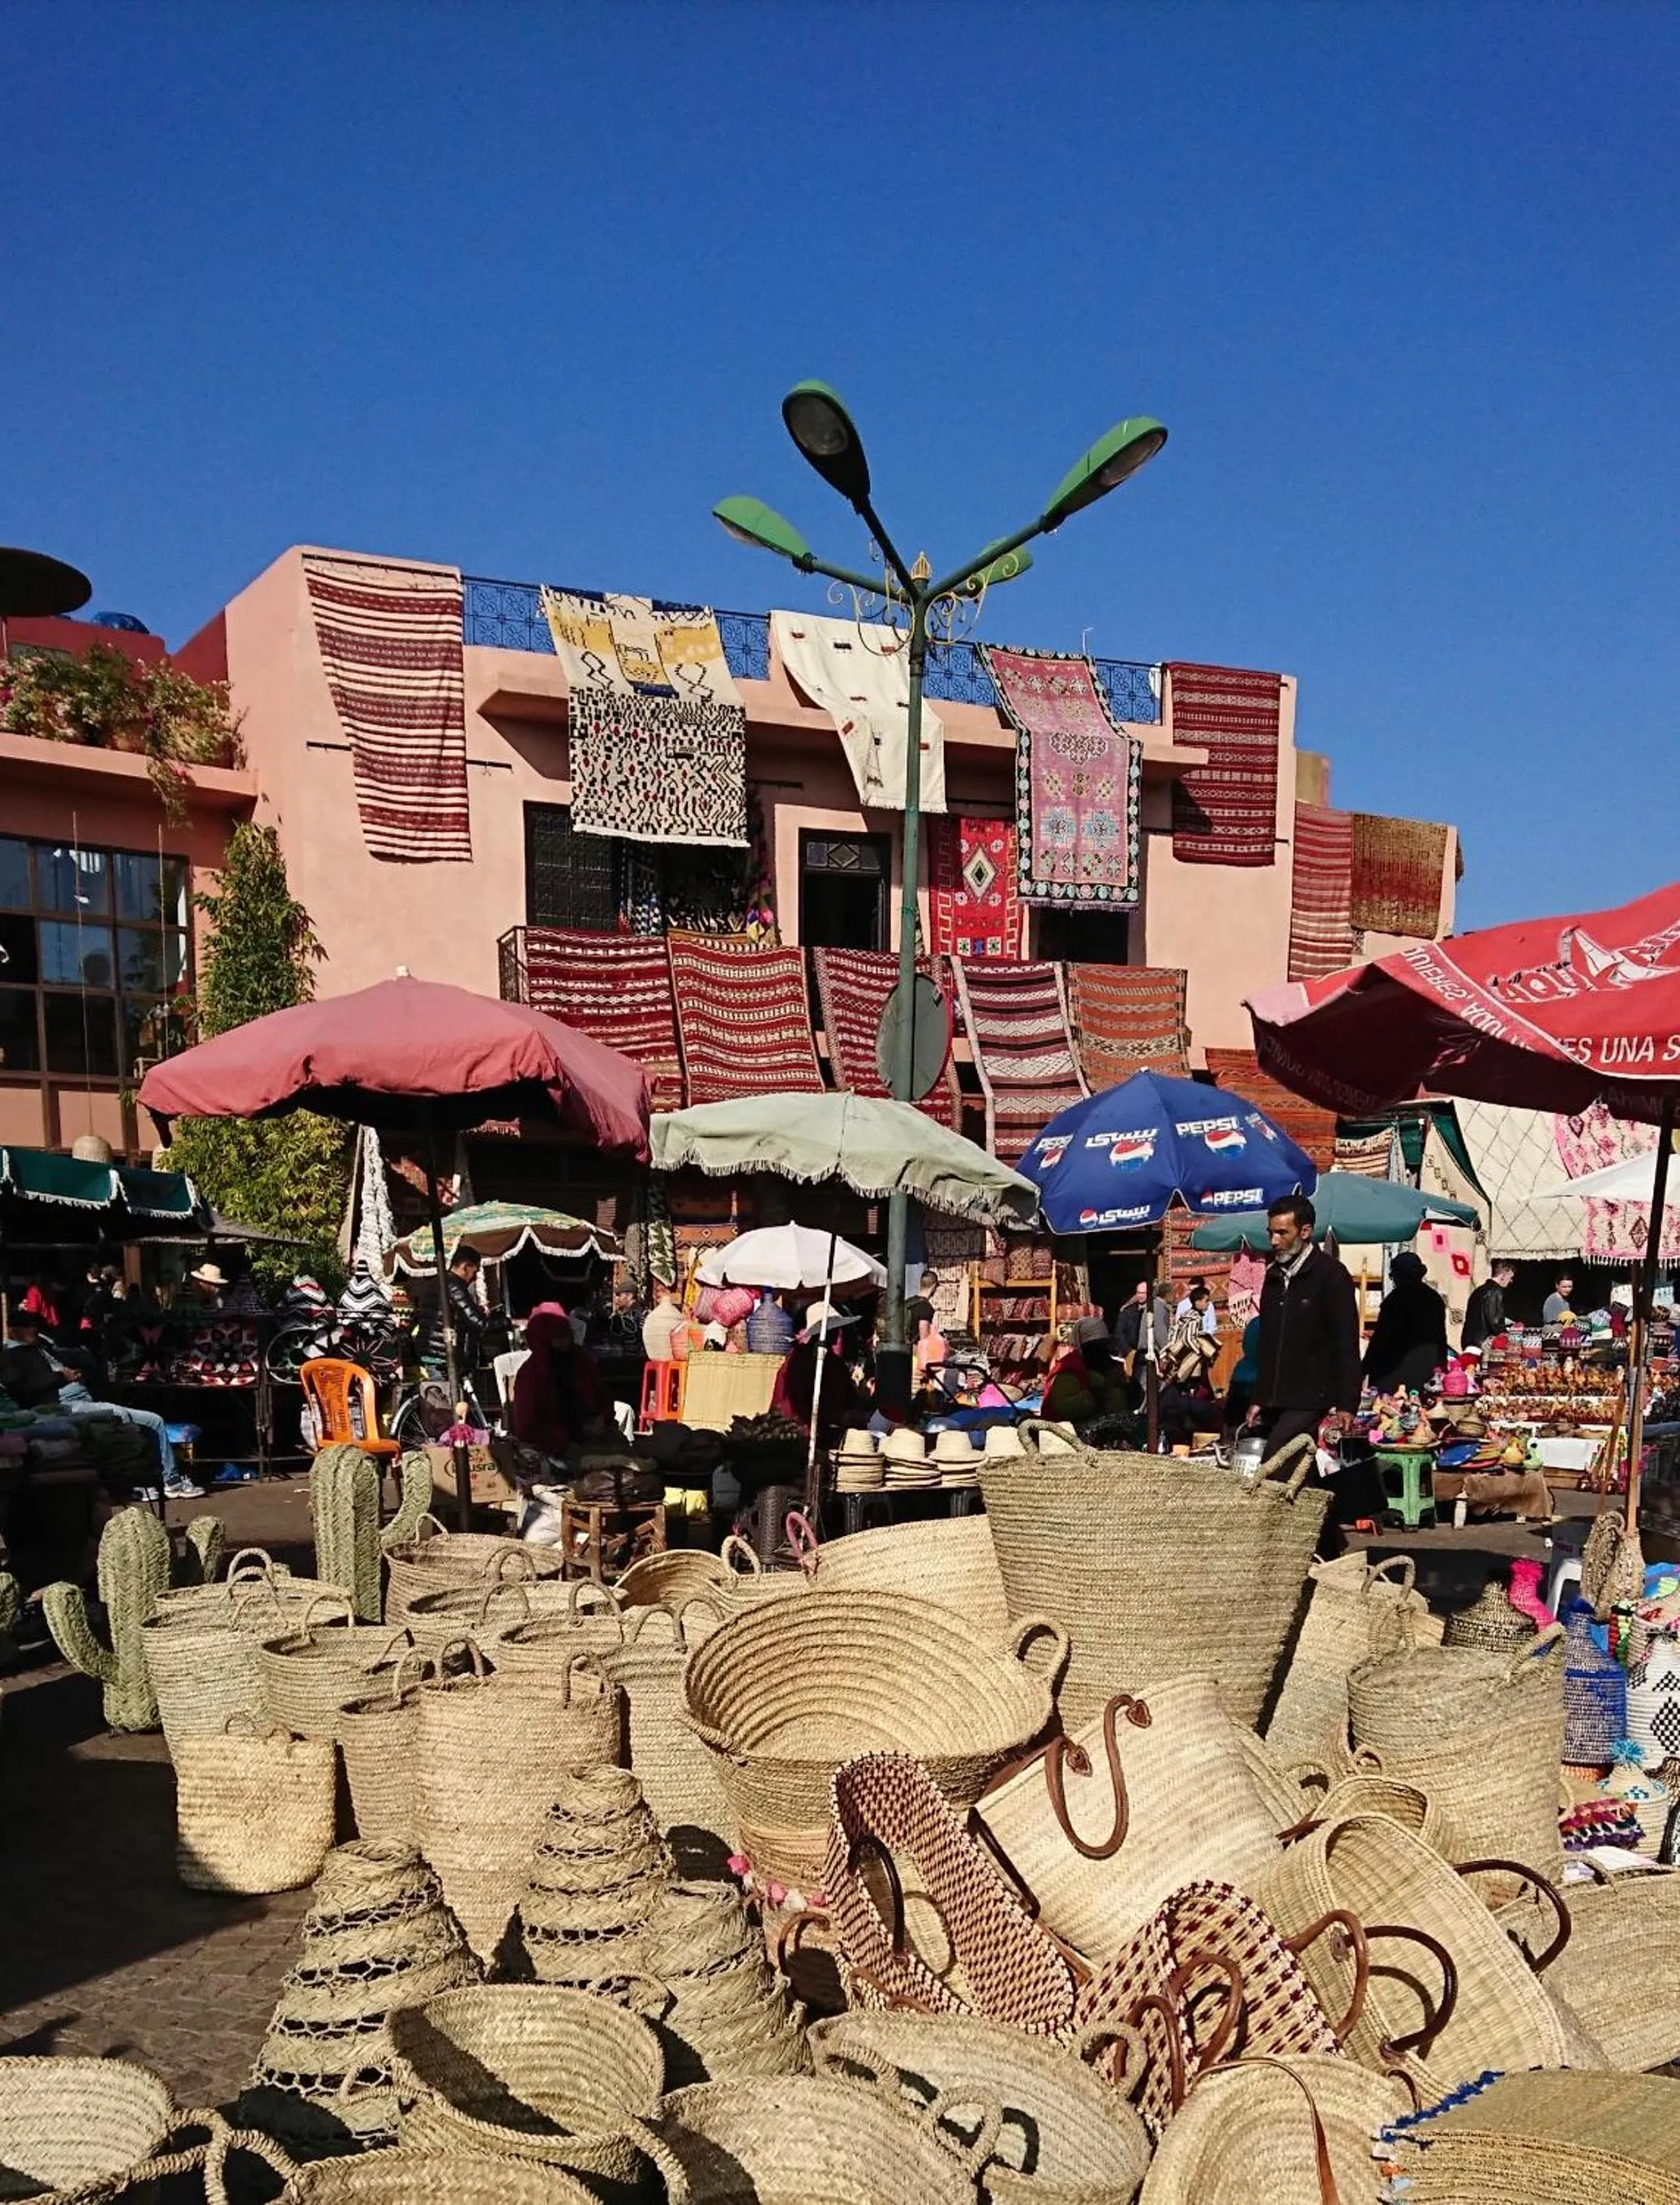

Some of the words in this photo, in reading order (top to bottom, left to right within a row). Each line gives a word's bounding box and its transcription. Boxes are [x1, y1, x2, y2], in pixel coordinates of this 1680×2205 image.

[1599, 1035, 1655, 1064] UNA
[1176, 1115, 1239, 1137] PEPSI
[1213, 1187, 1264, 1207] PEPSI
